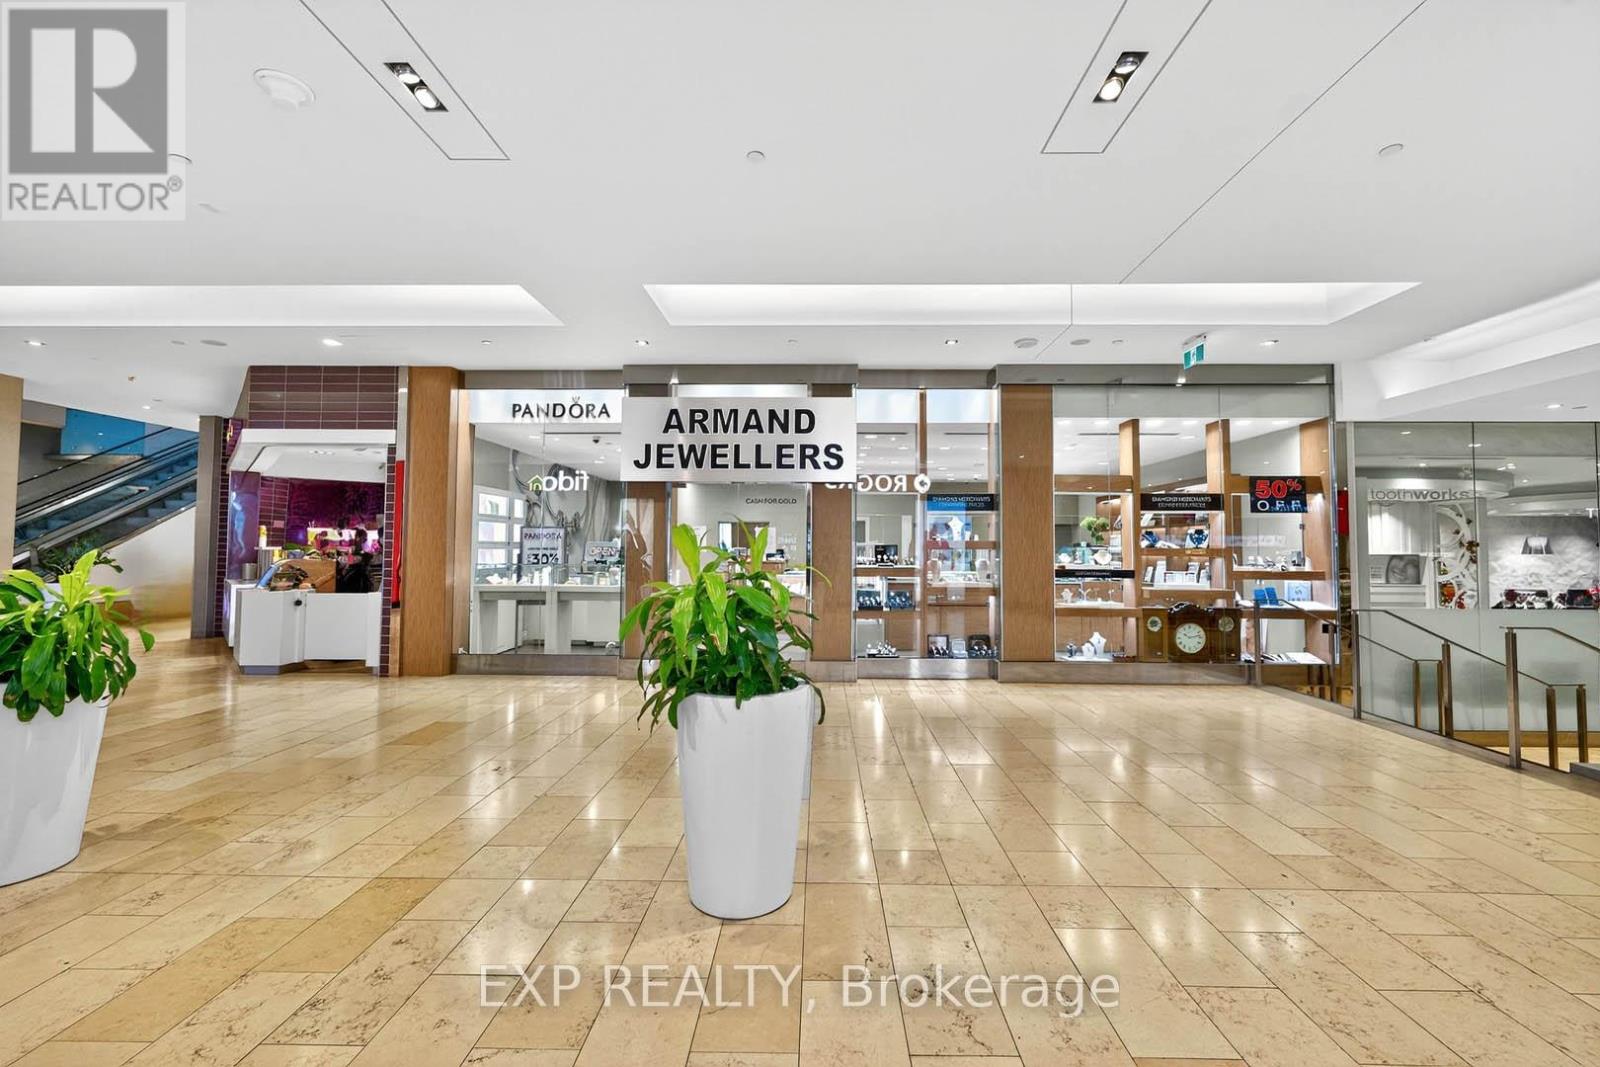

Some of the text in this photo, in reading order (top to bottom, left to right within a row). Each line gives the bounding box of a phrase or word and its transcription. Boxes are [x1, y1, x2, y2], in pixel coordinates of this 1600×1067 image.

[512, 401, 611, 419] PANDORA
[662, 408, 816, 434] ARMAND
[633, 443, 844, 470] JEWELLERS
[1255, 479, 1302, 499] 50%
[1371, 488, 1470, 500] toothworks
[532, 553, 560, 565] 30%
